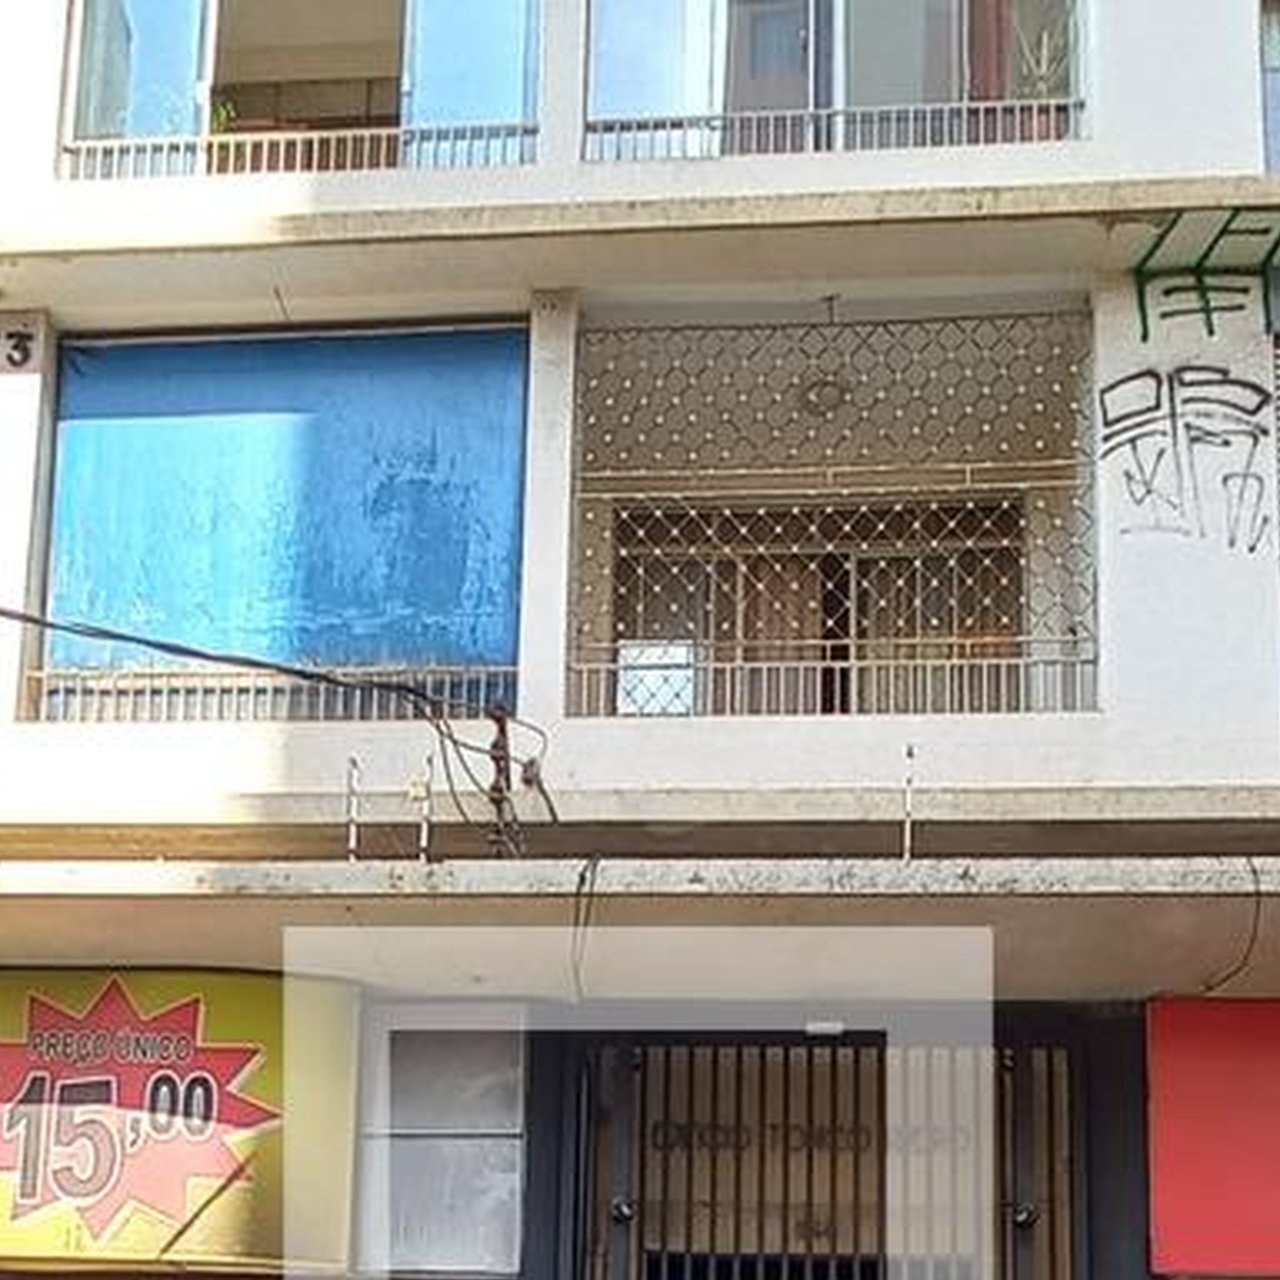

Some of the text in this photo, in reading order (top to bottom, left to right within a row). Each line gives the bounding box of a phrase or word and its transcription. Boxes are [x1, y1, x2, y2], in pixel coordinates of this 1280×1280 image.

[28, 1028, 192, 1064] PREÇO ÚNICO
[4, 1071, 217, 1206] 15,00
